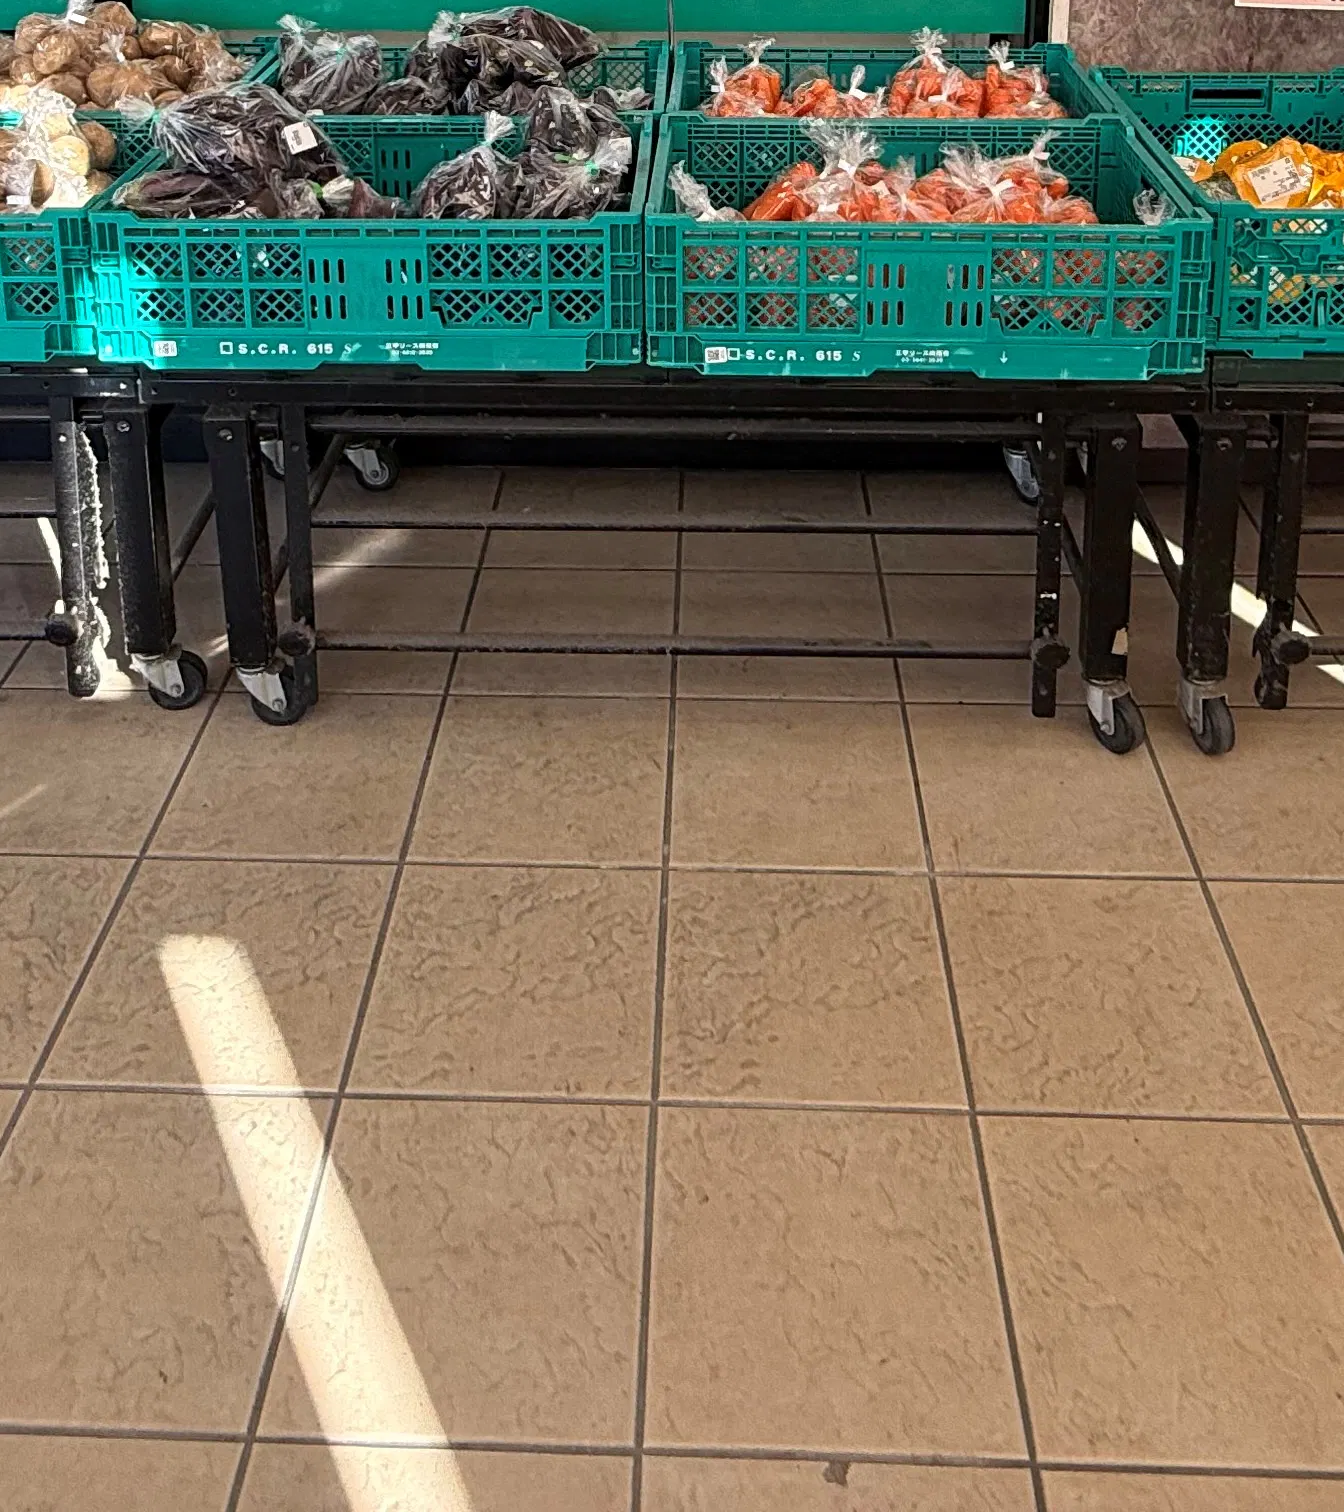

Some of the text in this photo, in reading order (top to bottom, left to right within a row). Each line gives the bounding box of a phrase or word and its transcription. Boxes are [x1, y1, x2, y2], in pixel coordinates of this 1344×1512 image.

[238, 343, 297, 355] S.C.R.
[307, 343, 333, 354] 615
[745, 349, 861, 362] S.C.R. 615 S
